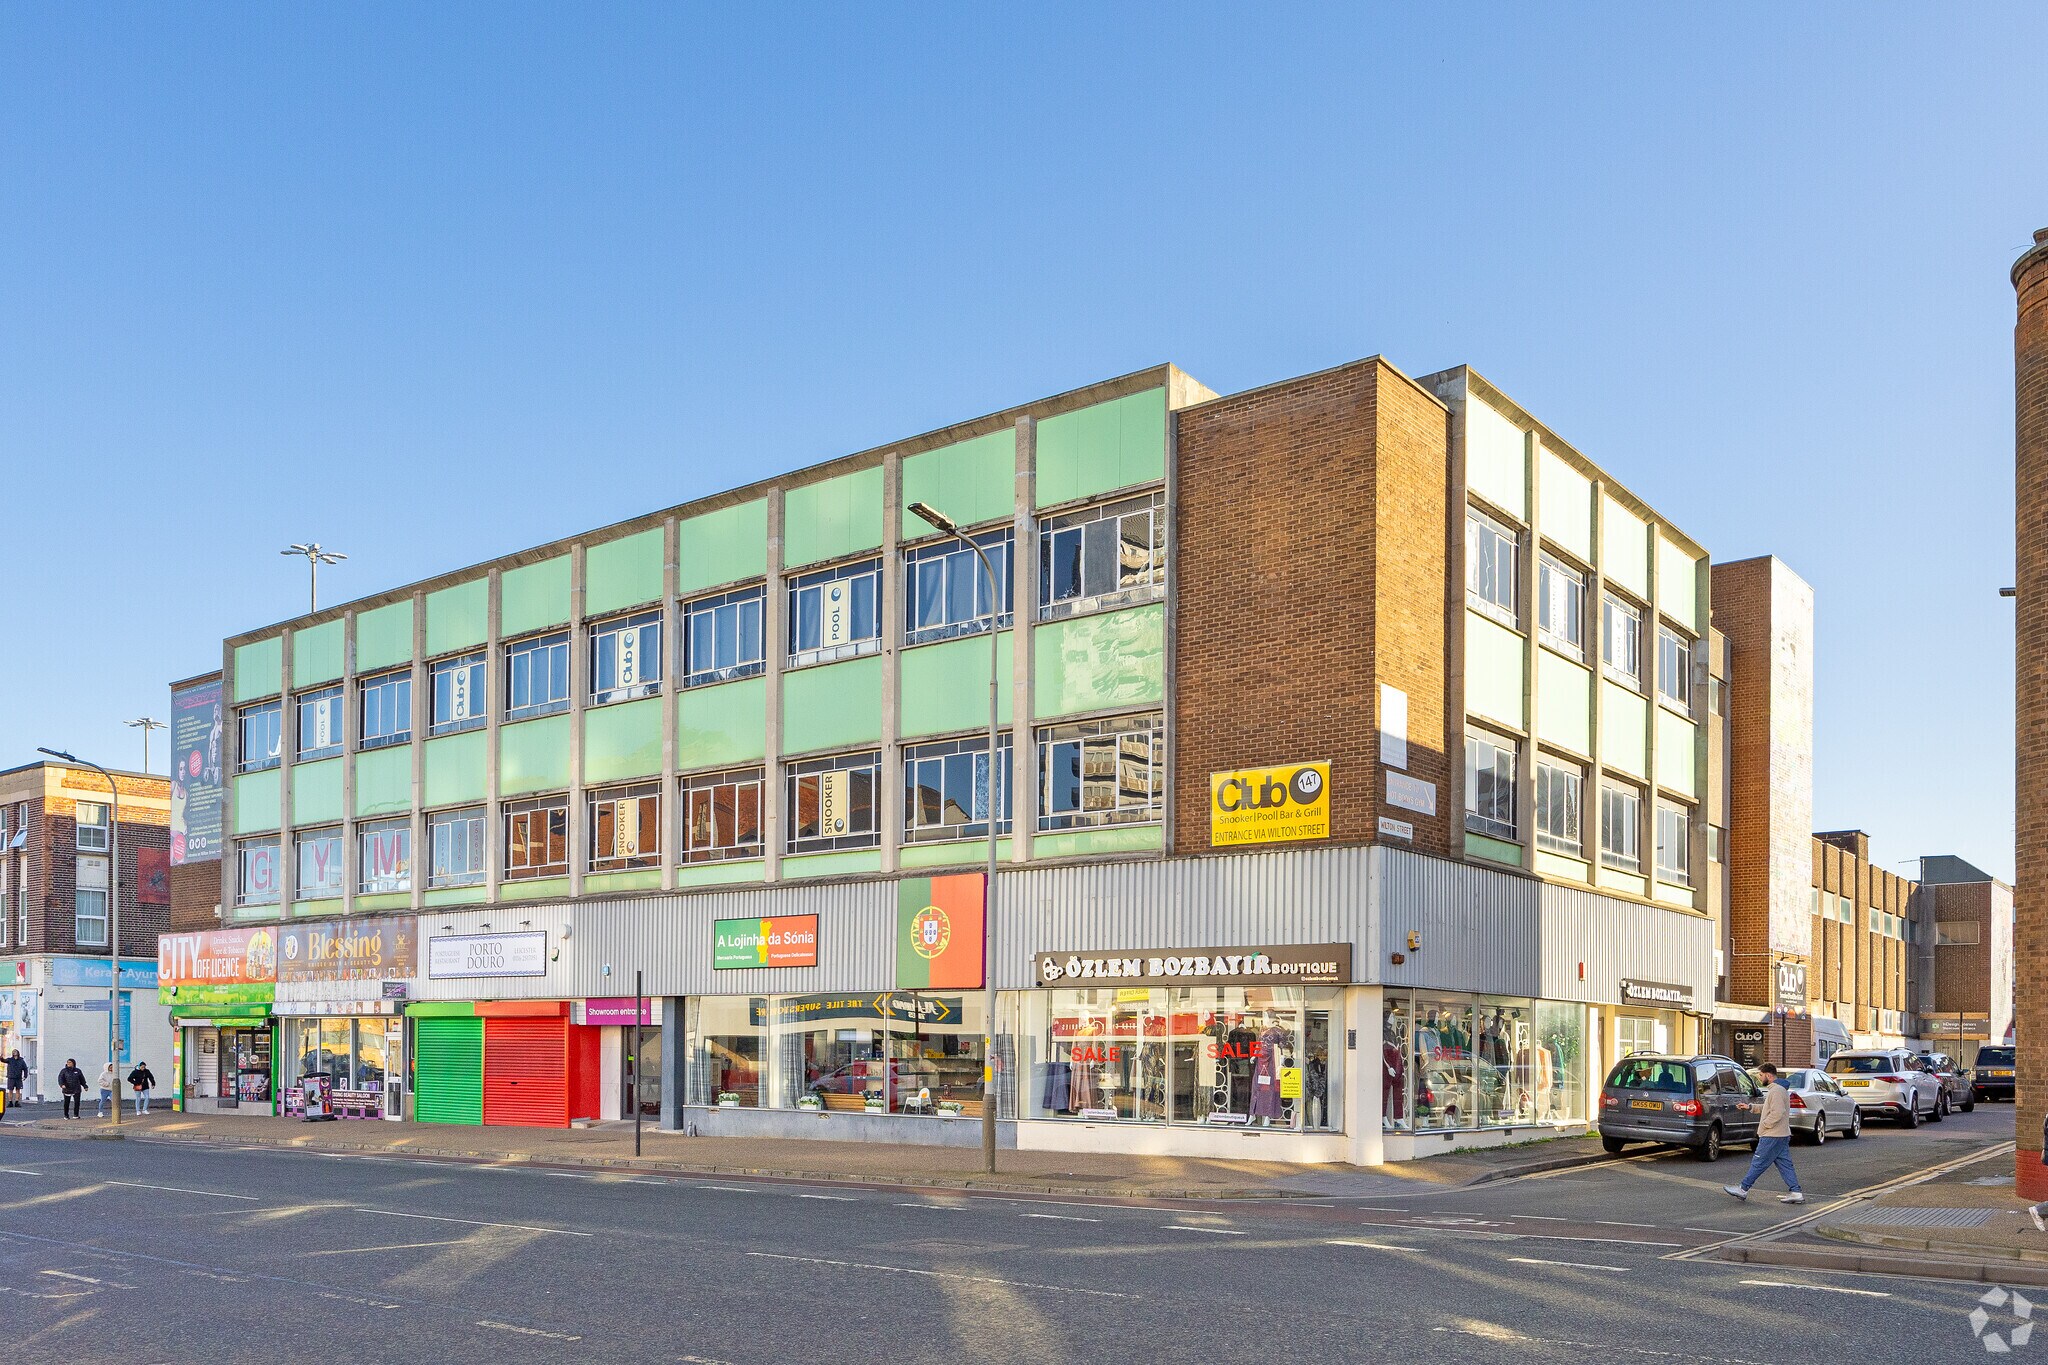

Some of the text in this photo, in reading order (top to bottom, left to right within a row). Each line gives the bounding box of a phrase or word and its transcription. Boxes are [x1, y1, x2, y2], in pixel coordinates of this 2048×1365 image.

[832, 606, 840, 640] POOL
[623, 650, 632, 683] Club
[456, 687, 464, 716] Club
[1299, 773, 1319, 791] 147
[1217, 776, 1287, 812] Club
[1296, 809, 1302, 818] &
[1304, 807, 1322, 818] Grill
[1215, 824, 1326, 842] ENTRANCE VIA WILTON STREET
[1380, 820, 1412, 835] WILTON STREET
[308, 930, 381, 965] Blessing
[717, 930, 814, 949] A Lojinha da Sónia
[160, 936, 201, 979] CITY
[469, 942, 502, 956] PORTO
[198, 958, 240, 978] OFF LICENCE
[467, 955, 504, 969] DOURO
[1066, 956, 1143, 979] ÖZLEM
[1272, 962, 1337, 975] BOUTIQUE
[85, 967, 122, 978] Keraa
[1779, 964, 1796, 992] Club
[1629, 982, 1650, 999] ÖZLEM
[589, 1008, 619, 1016] Showroom
[1735, 1032, 1753, 1040] Club
[1071, 1046, 1121, 1063] SALE
[1207, 1041, 1264, 1059] SALE
[1434, 1046, 1462, 1061] SALE
